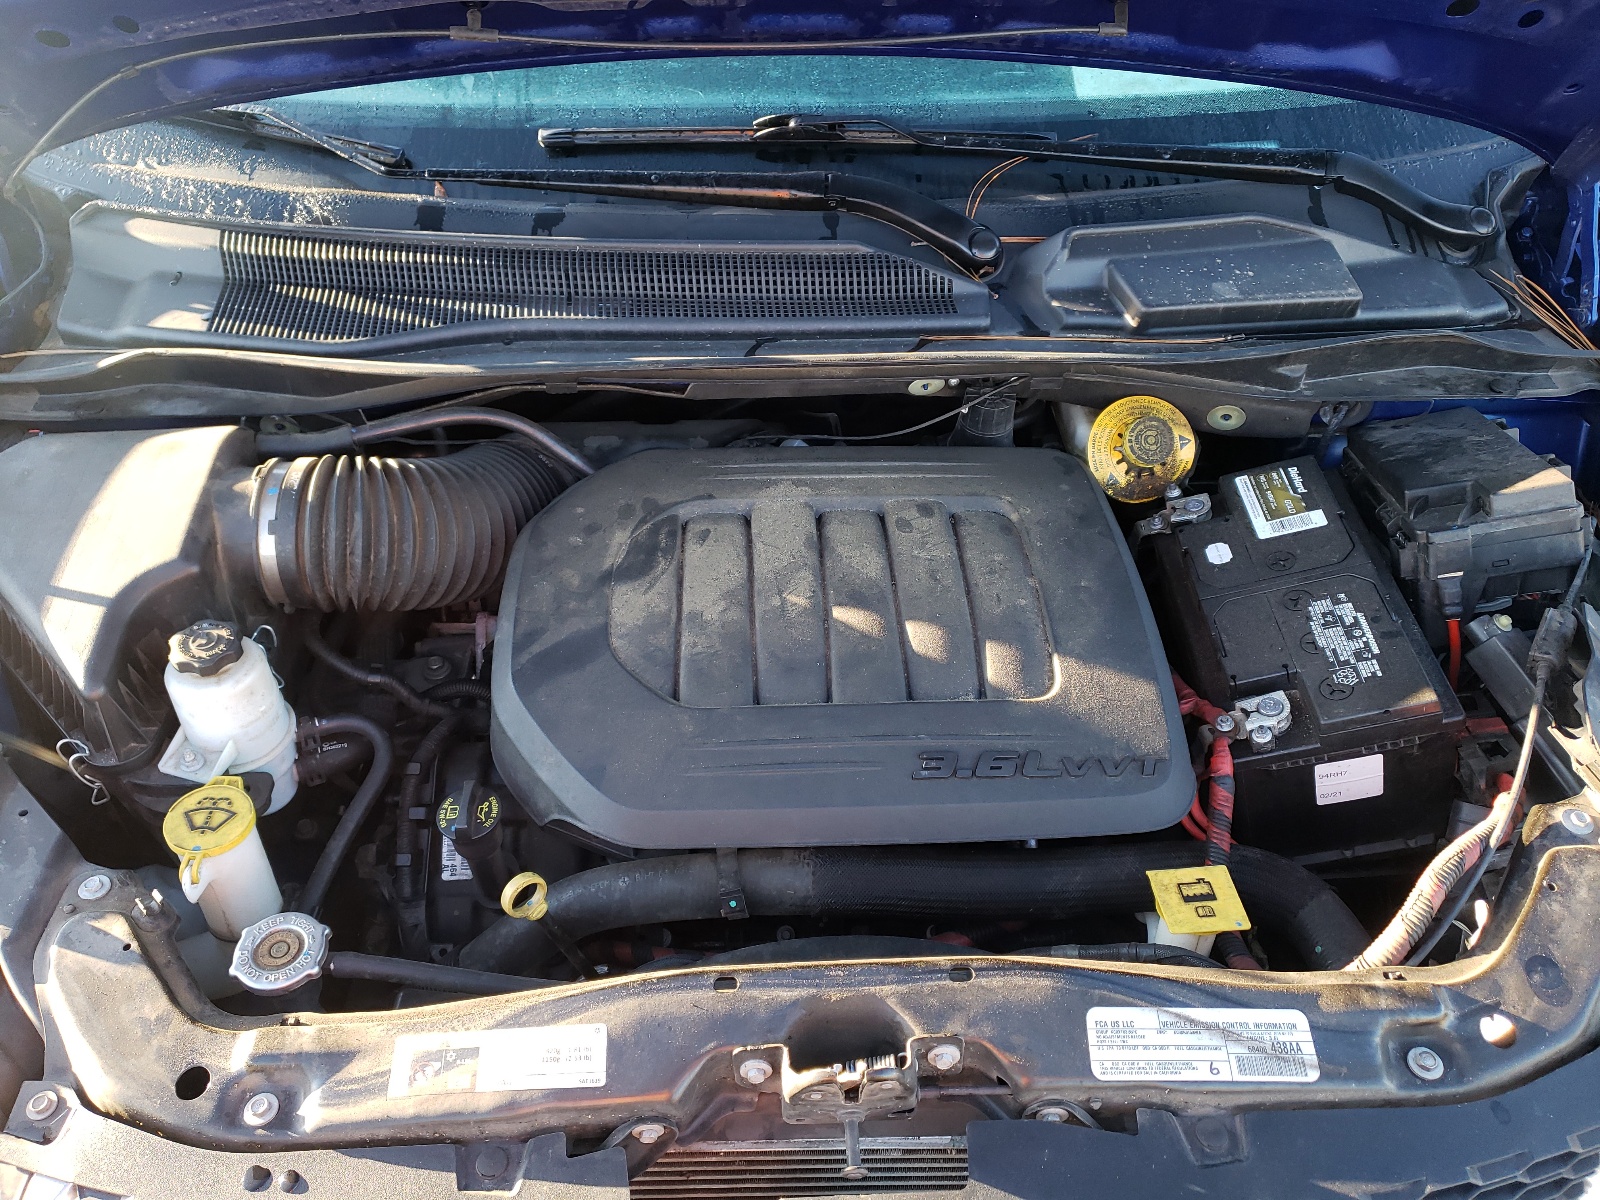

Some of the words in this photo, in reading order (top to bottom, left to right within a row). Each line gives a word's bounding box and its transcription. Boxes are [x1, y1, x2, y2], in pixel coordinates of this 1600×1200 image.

[1287, 466, 1308, 493] DieHard
[912, 750, 1062, 781] 3.6L
[1318, 770, 1348, 780] 94RH7
[1319, 791, 1342, 799] 02/21
[442, 797, 454, 809] SAE
[489, 796, 499, 818] ENGINE
[482, 818, 495, 828] OIL
[449, 863, 458, 877] 464
[253, 917, 285, 936] KEEP
[290, 916, 316, 934] TIGHT
[239, 950, 250, 964] DO
[295, 949, 314, 969] HOT
[242, 963, 263, 980] NOT
[263, 968, 296, 982] OPEN
[1095, 1020, 1109, 1028] FCA
[1111, 1020, 1120, 1028] US
[1122, 1020, 1135, 1028] LLC
[1161, 1021, 1187, 1029] VEHICLE
[1190, 1021, 1220, 1029] EMISSION
[1221, 1021, 1251, 1030] CONTROL
[1253, 1022, 1297, 1031] INFORMATION
[1271, 1042, 1303, 1054] 438AA
[1209, 1061, 1220, 1076] 6
